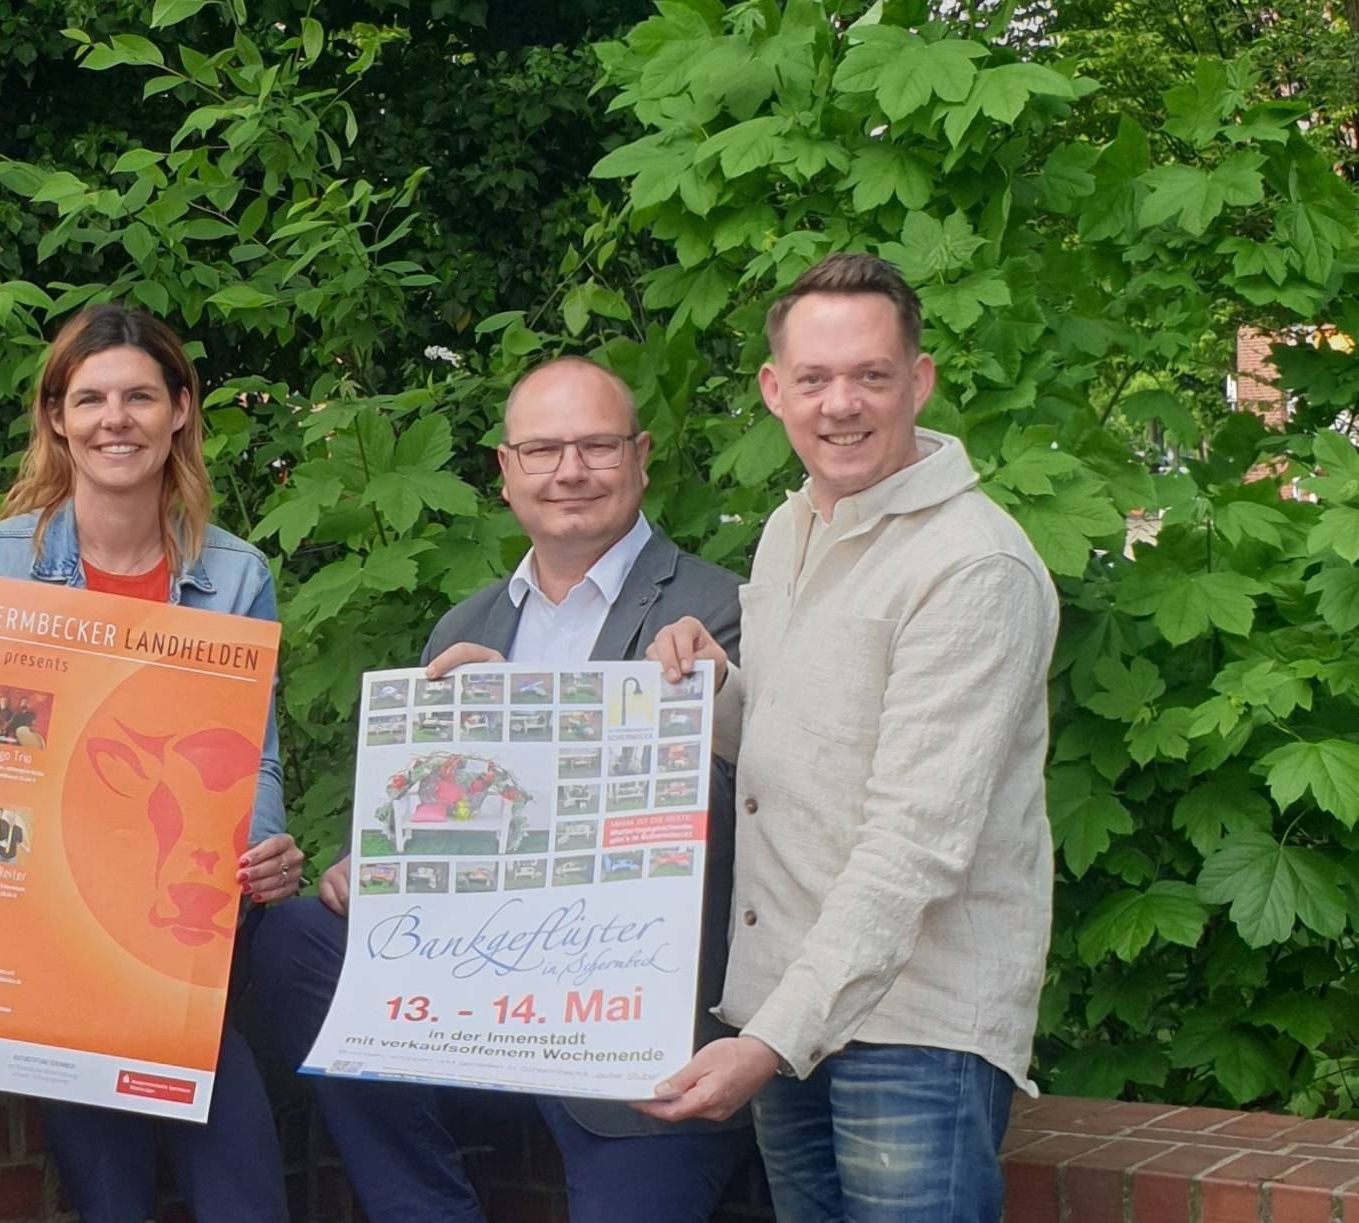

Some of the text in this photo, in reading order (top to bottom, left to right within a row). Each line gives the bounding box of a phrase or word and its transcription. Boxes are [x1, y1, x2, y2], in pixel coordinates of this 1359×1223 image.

[3, 651, 69, 673] presents
[124, 628, 259, 671] LANDHELDEN
[14, 750, 33, 764] Trio
[366, 898, 664, 979] Bankgeflüster
[557, 943, 681, 986] Schermbeck
[385, 995, 439, 1023] 13.
[492, 994, 546, 1024] 14.
[564, 986, 643, 1024] Mai
[345, 1035, 665, 1062] mit verkaufsoffenem Wochenende
[428, 1028, 587, 1046] in der Innenstadt
